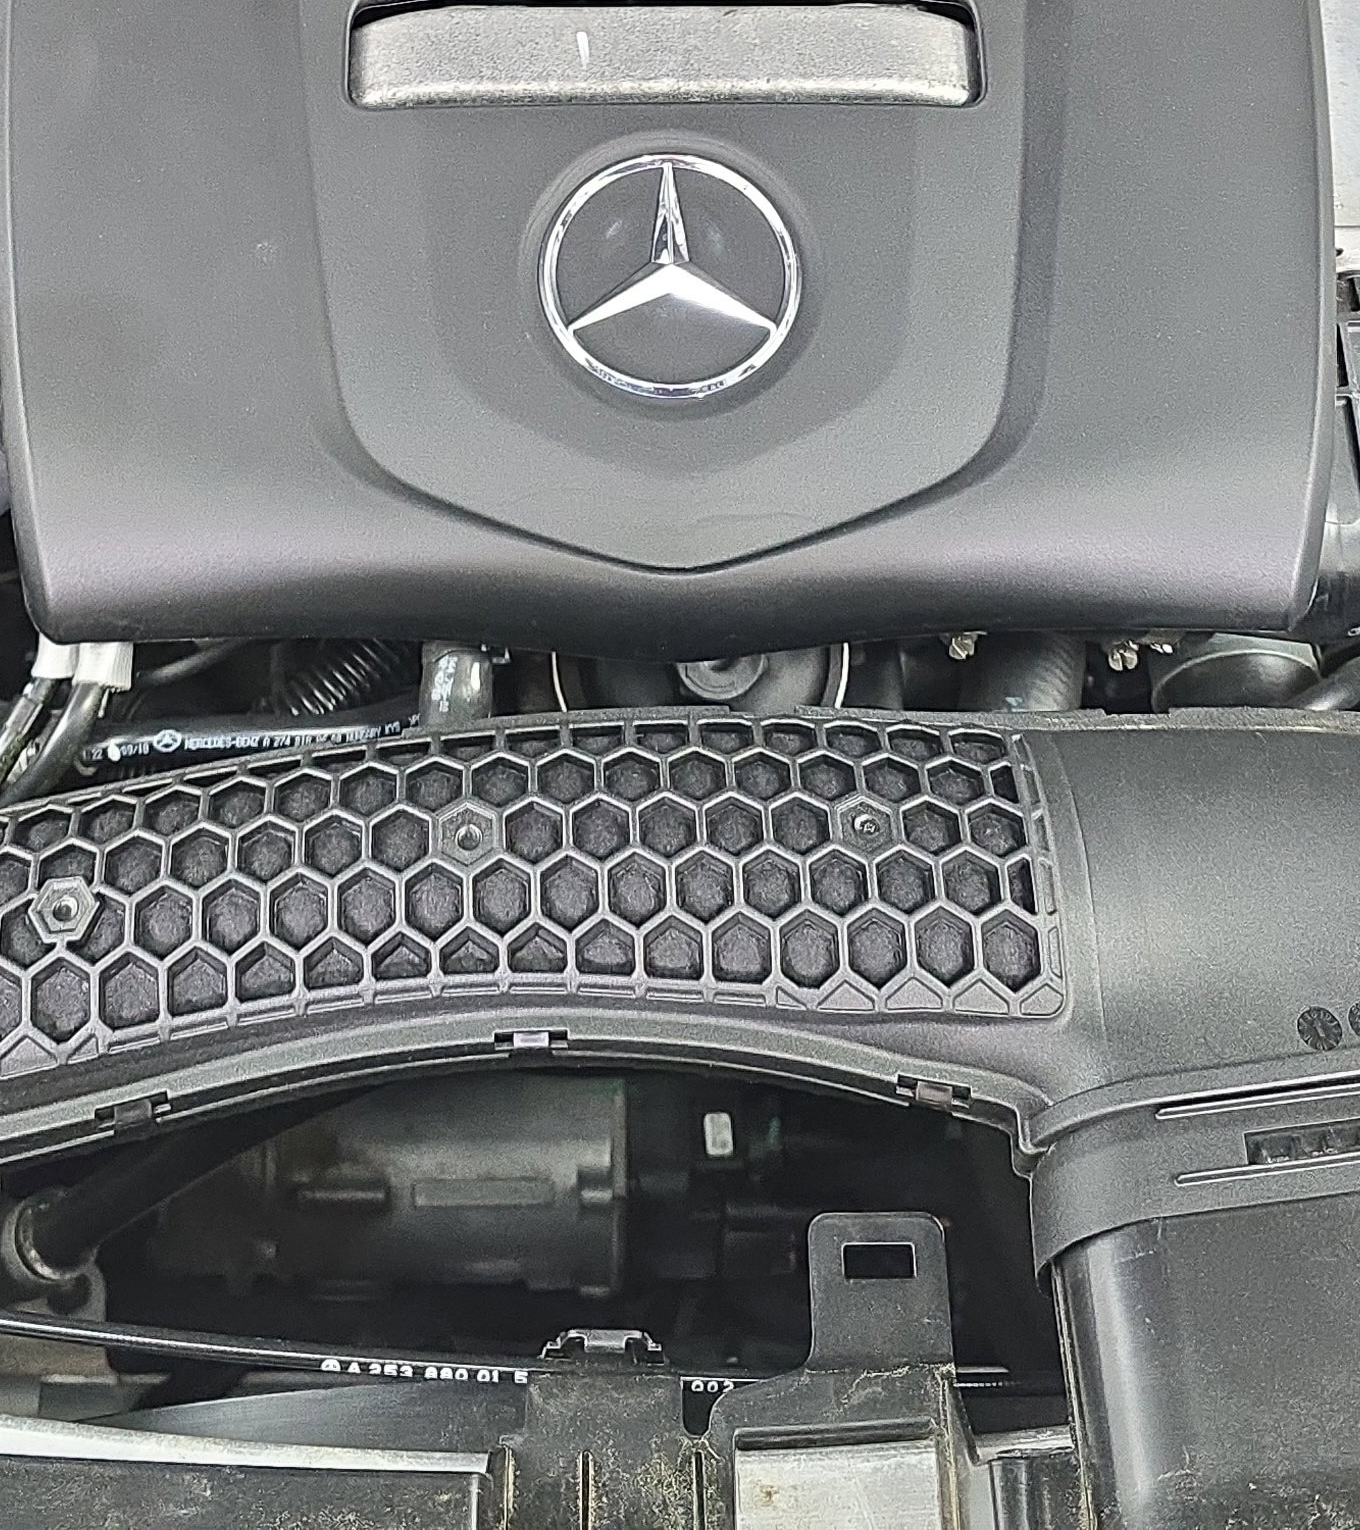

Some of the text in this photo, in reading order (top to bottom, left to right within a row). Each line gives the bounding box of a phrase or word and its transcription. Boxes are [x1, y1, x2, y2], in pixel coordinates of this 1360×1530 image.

[347, 1362, 361, 1374] A
[368, 1363, 414, 1379] 253
[424, 1366, 469, 1382] 880
[476, 1368, 500, 1383] 01
